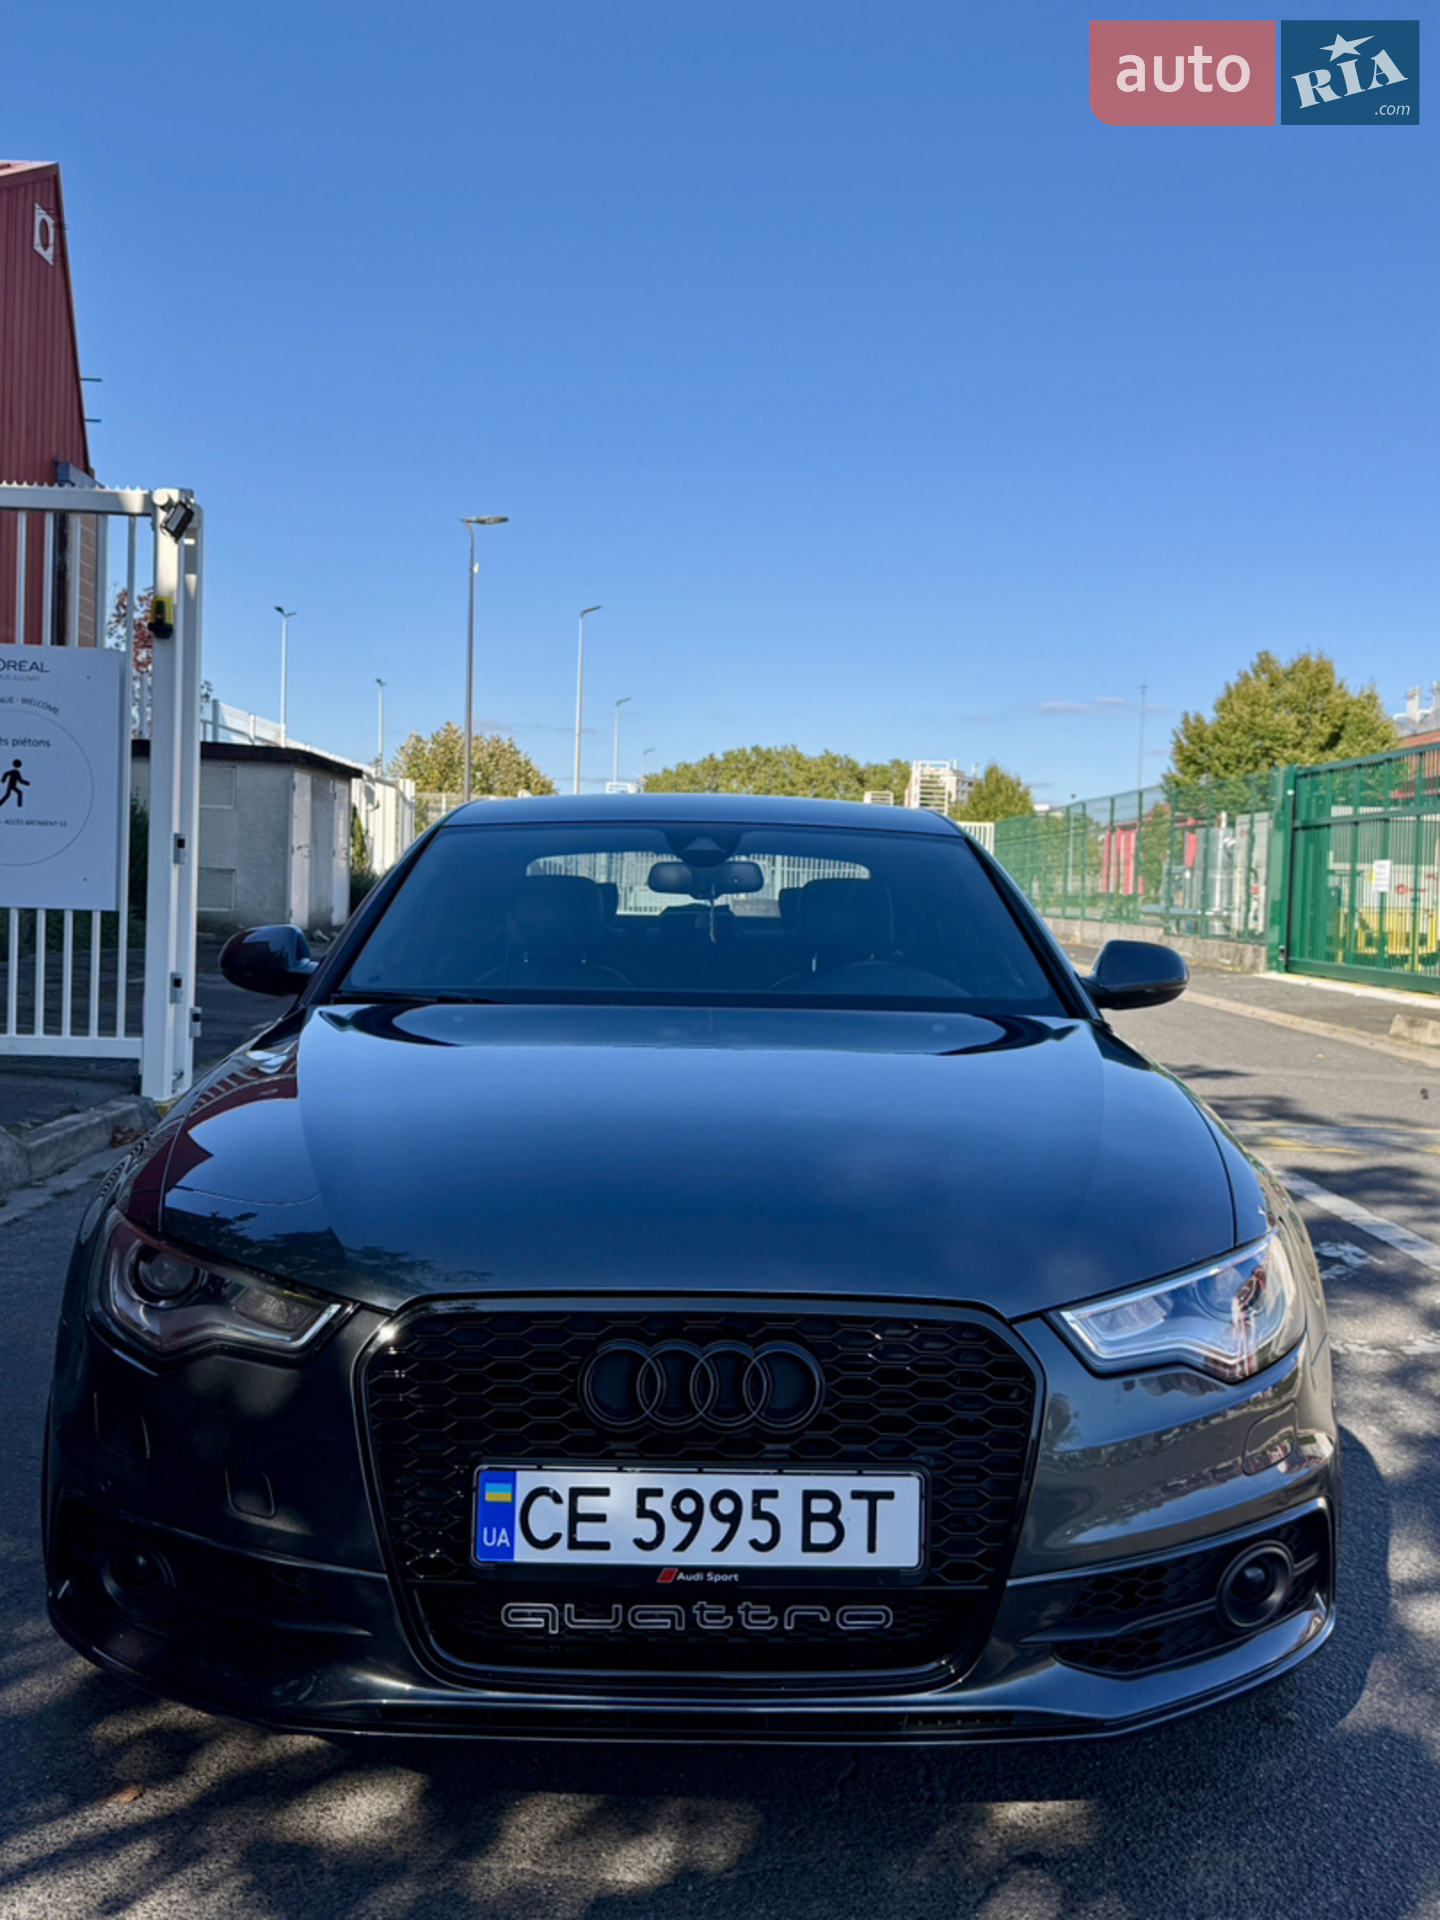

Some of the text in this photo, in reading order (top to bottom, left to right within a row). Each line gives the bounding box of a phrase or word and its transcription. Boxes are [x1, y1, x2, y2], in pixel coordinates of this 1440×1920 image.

[12, 736, 51, 748] piétons
[519, 1486, 896, 1554] CE 5995 BT
[483, 1527, 511, 1548] UA
[677, 1572, 739, 1583] Audi Sport
[501, 1602, 894, 1635] quattro
